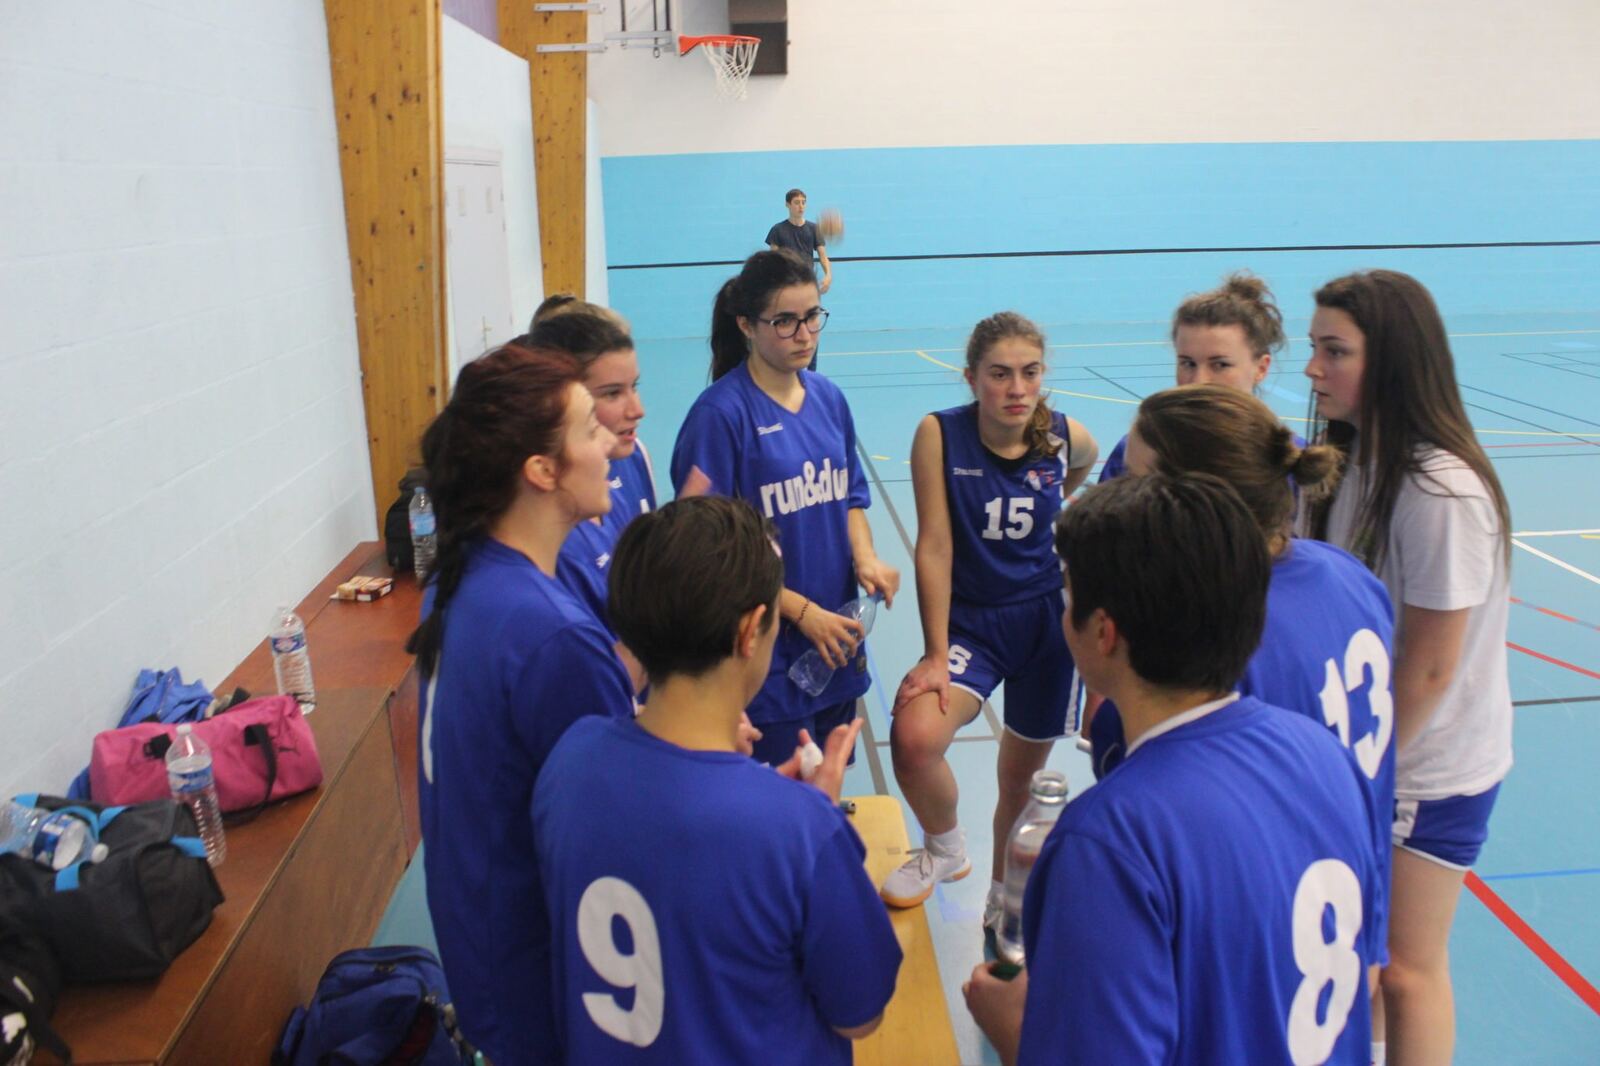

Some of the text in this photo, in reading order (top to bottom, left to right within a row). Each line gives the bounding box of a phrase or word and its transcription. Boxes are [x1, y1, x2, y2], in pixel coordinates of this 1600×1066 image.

[760, 458, 848, 518] run&du
[982, 497, 1034, 540] 15
[1318, 628, 1393, 779] 13
[577, 876, 665, 1047] 9
[1287, 858, 1363, 1066] 8
